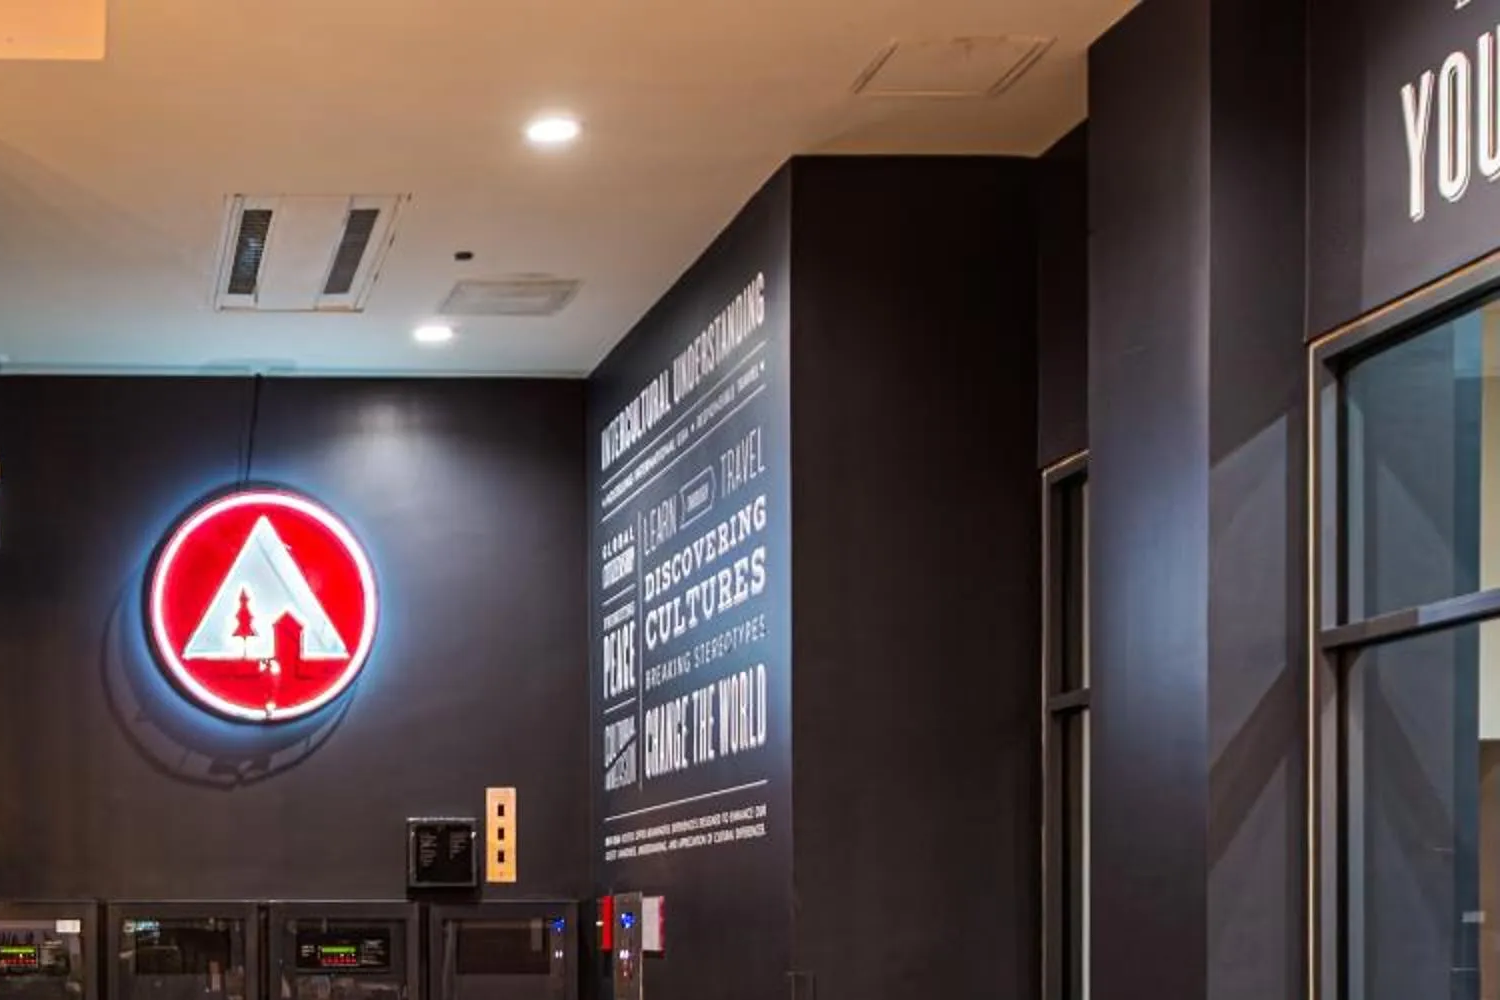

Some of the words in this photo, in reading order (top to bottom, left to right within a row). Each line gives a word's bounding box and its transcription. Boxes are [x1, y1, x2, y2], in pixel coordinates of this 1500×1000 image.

[673, 271, 766, 404] UNDERSTANDING
[602, 524, 635, 560] GLOBAL
[643, 494, 677, 556] LEARN
[720, 426, 766, 498] TRAVEL
[644, 546, 767, 650] CULTURES
[645, 495, 767, 602] DISCOVERING
[603, 620, 636, 700] PEACE
[645, 651, 691, 690] BREAKING
[694, 613, 766, 668] STEREOTYPES
[645, 695, 689, 779] CHANGE
[691, 683, 716, 764] THE
[718, 663, 767, 757] WORLD
